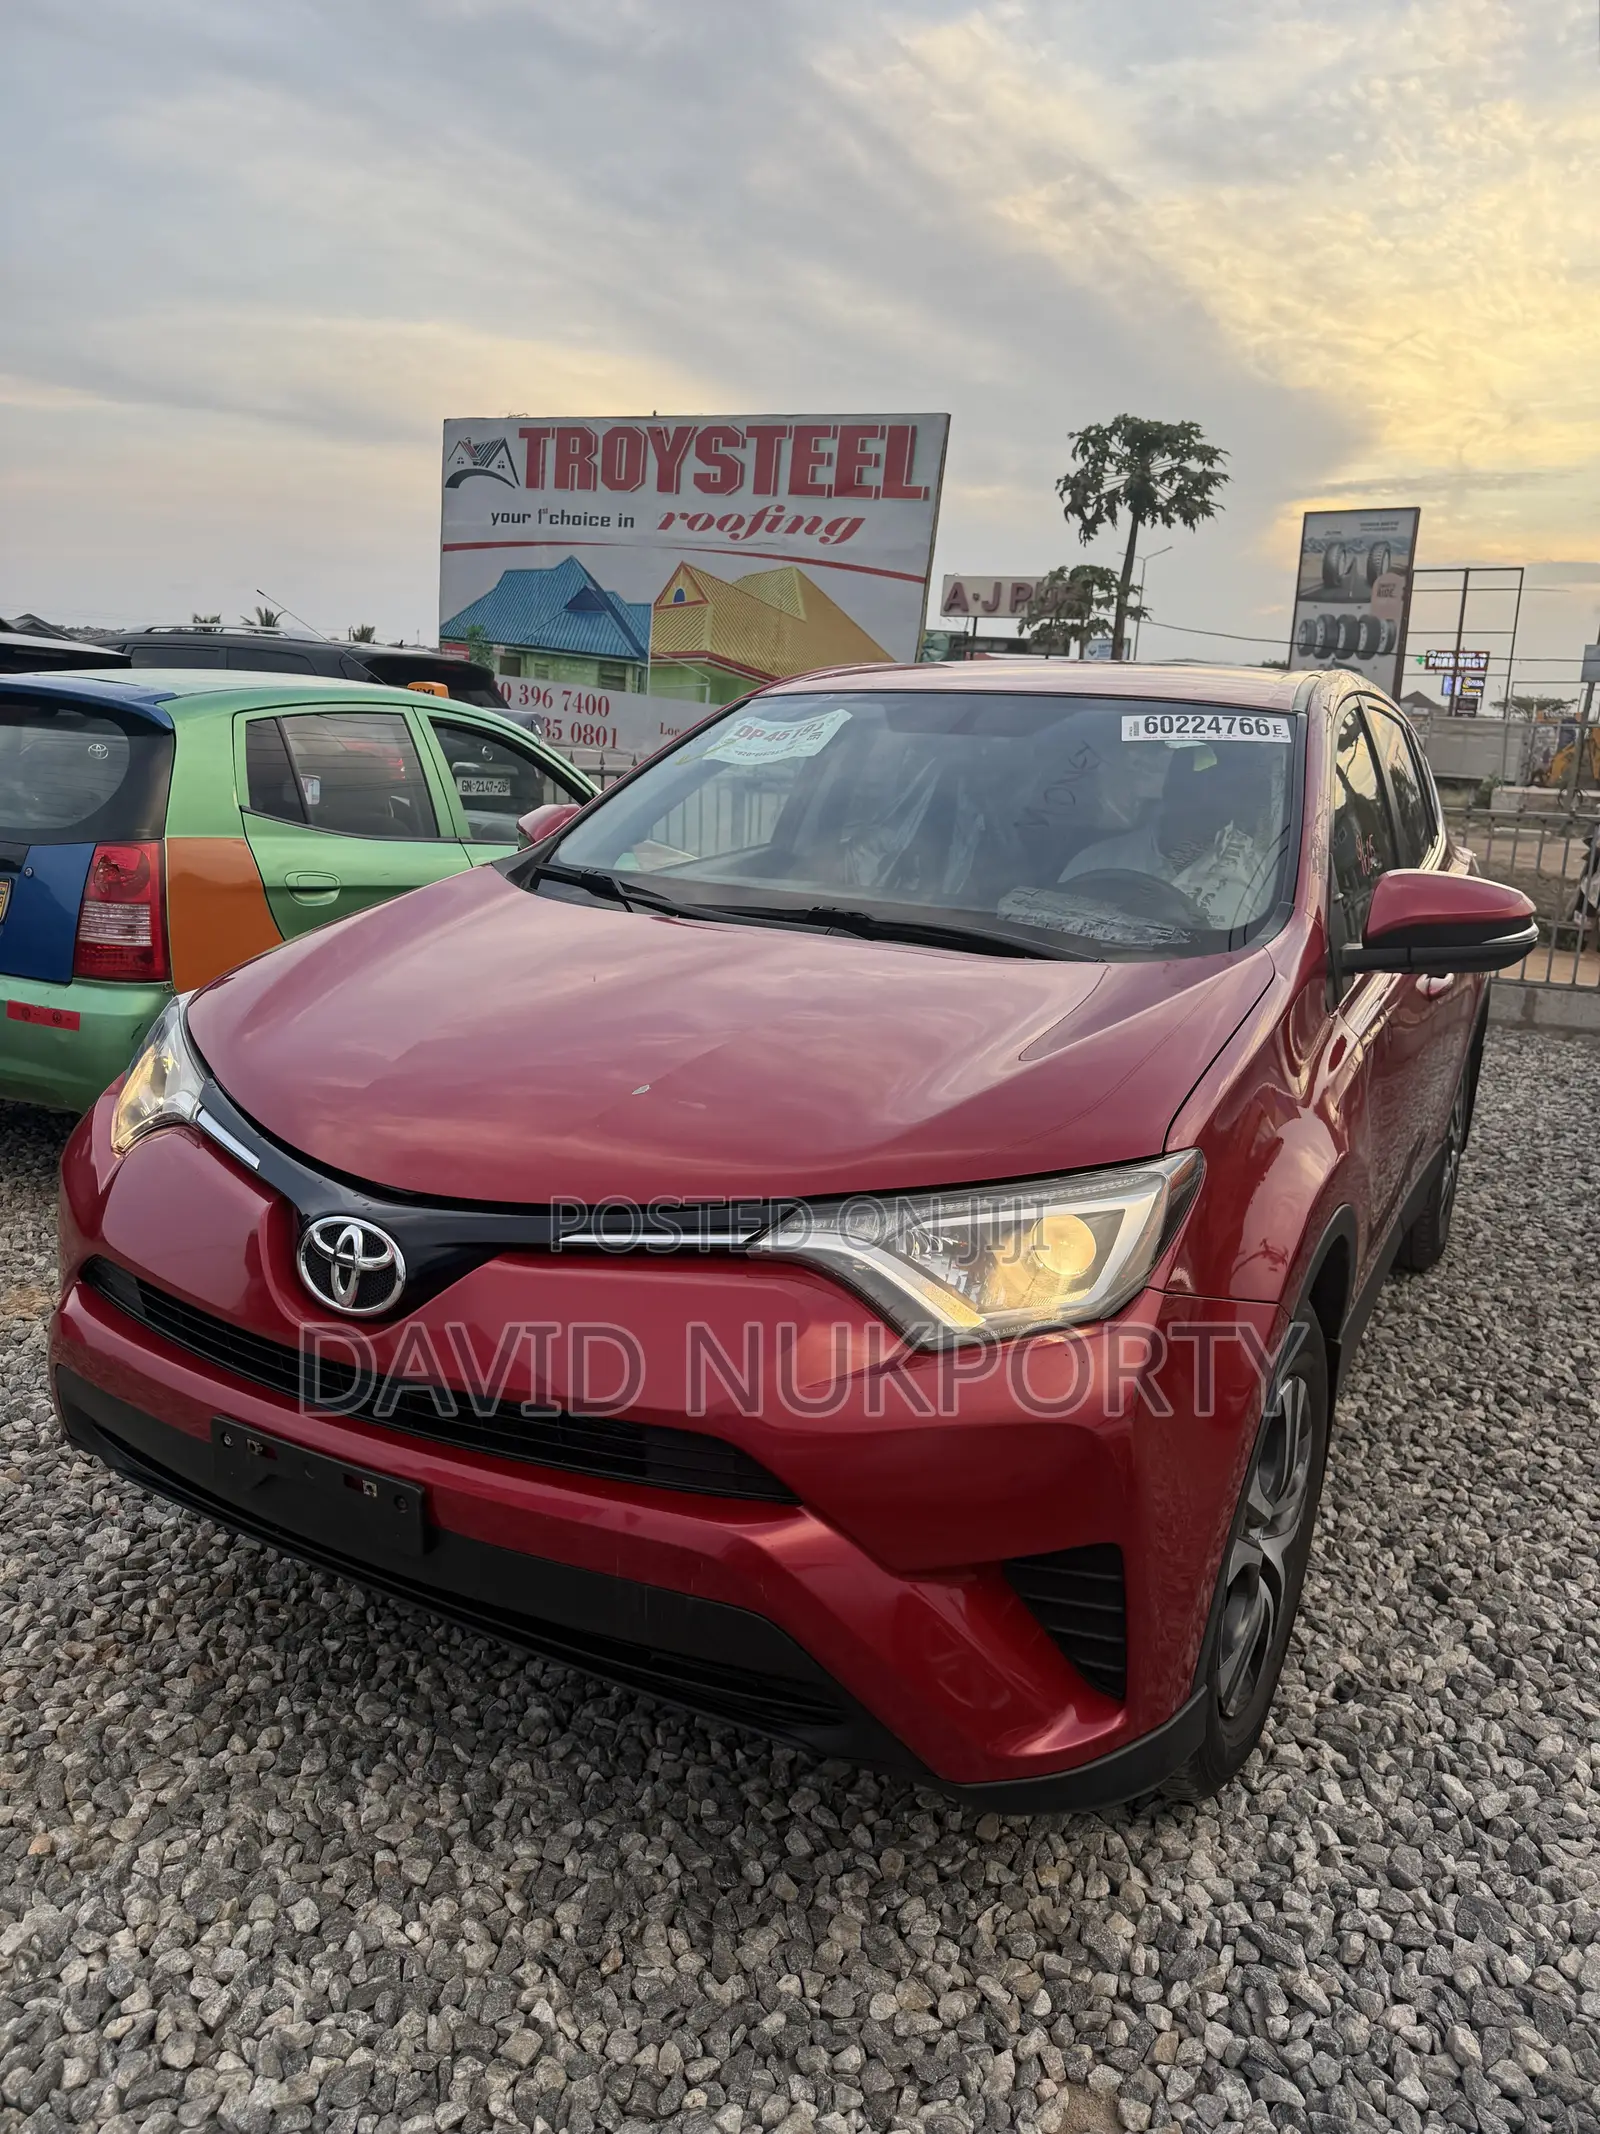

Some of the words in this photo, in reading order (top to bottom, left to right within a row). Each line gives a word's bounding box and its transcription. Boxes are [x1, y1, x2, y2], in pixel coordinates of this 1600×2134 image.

[518, 425, 930, 501] TROYSTEEL
[491, 512, 531, 526] your
[549, 509, 611, 527] choice
[618, 512, 635, 528] in
[656, 504, 866, 545] roofing
[493, 680, 512, 703] 0
[518, 683, 554, 709] 396
[561, 690, 610, 718] 7400
[570, 721, 618, 749] 0801
